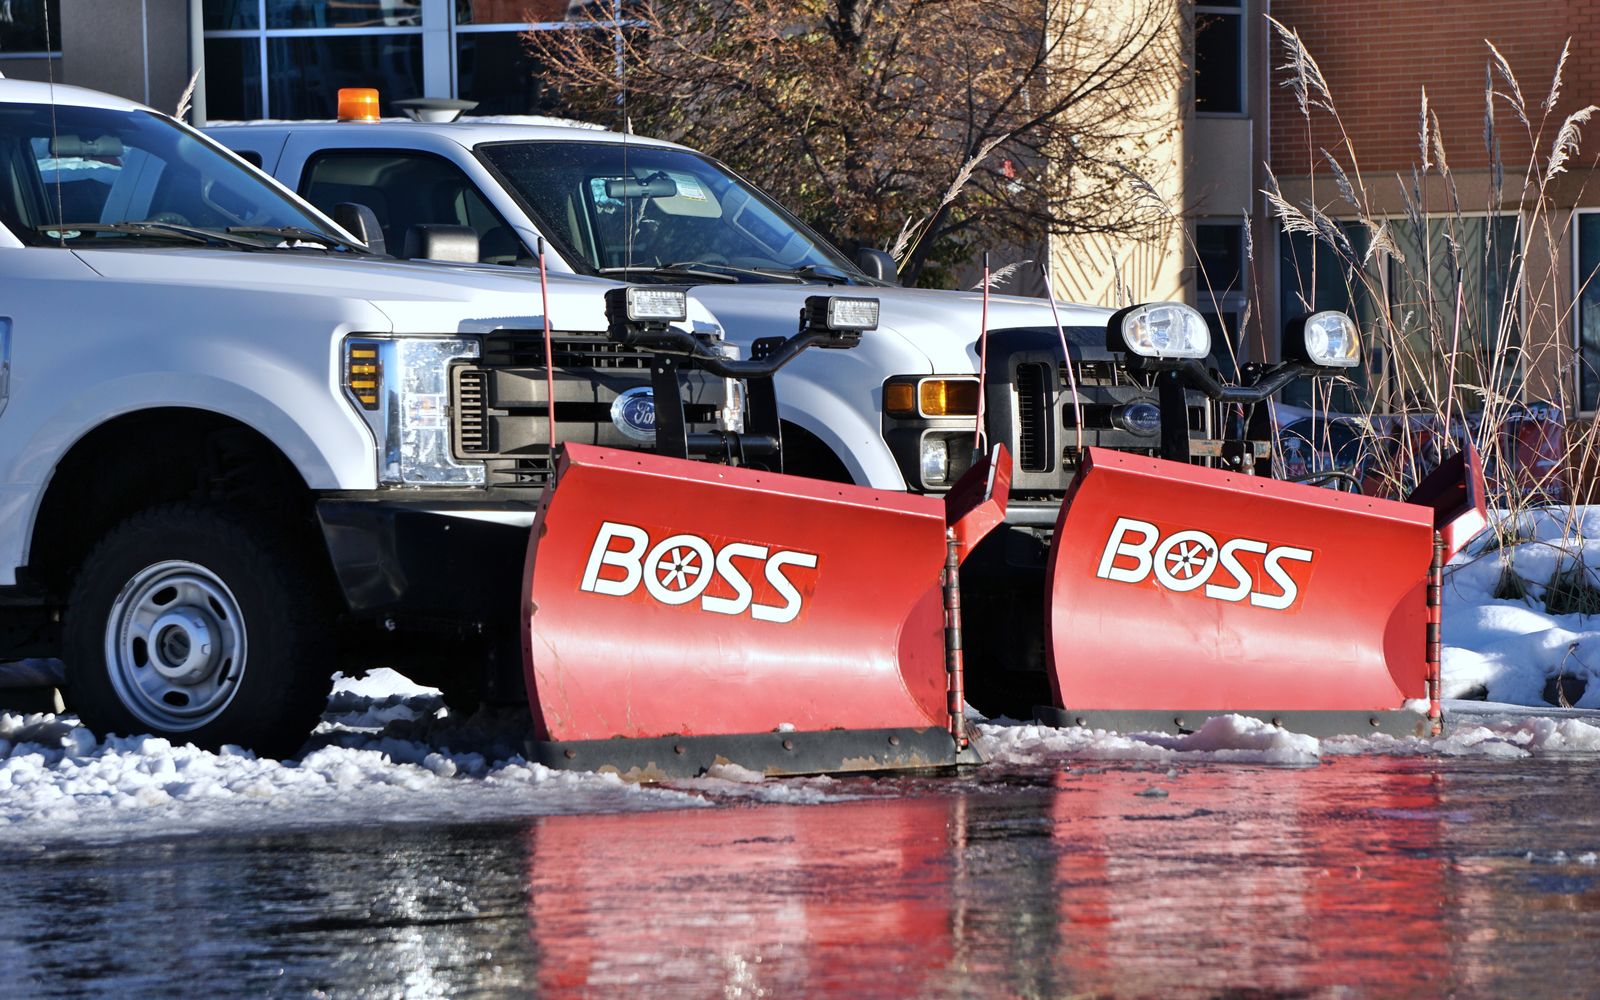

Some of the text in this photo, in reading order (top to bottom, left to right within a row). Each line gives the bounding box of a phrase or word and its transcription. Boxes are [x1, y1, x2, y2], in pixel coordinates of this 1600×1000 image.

[634, 400, 656, 425] For
[580, 521, 818, 624] BOSS
[1096, 517, 1313, 610] BOSS
